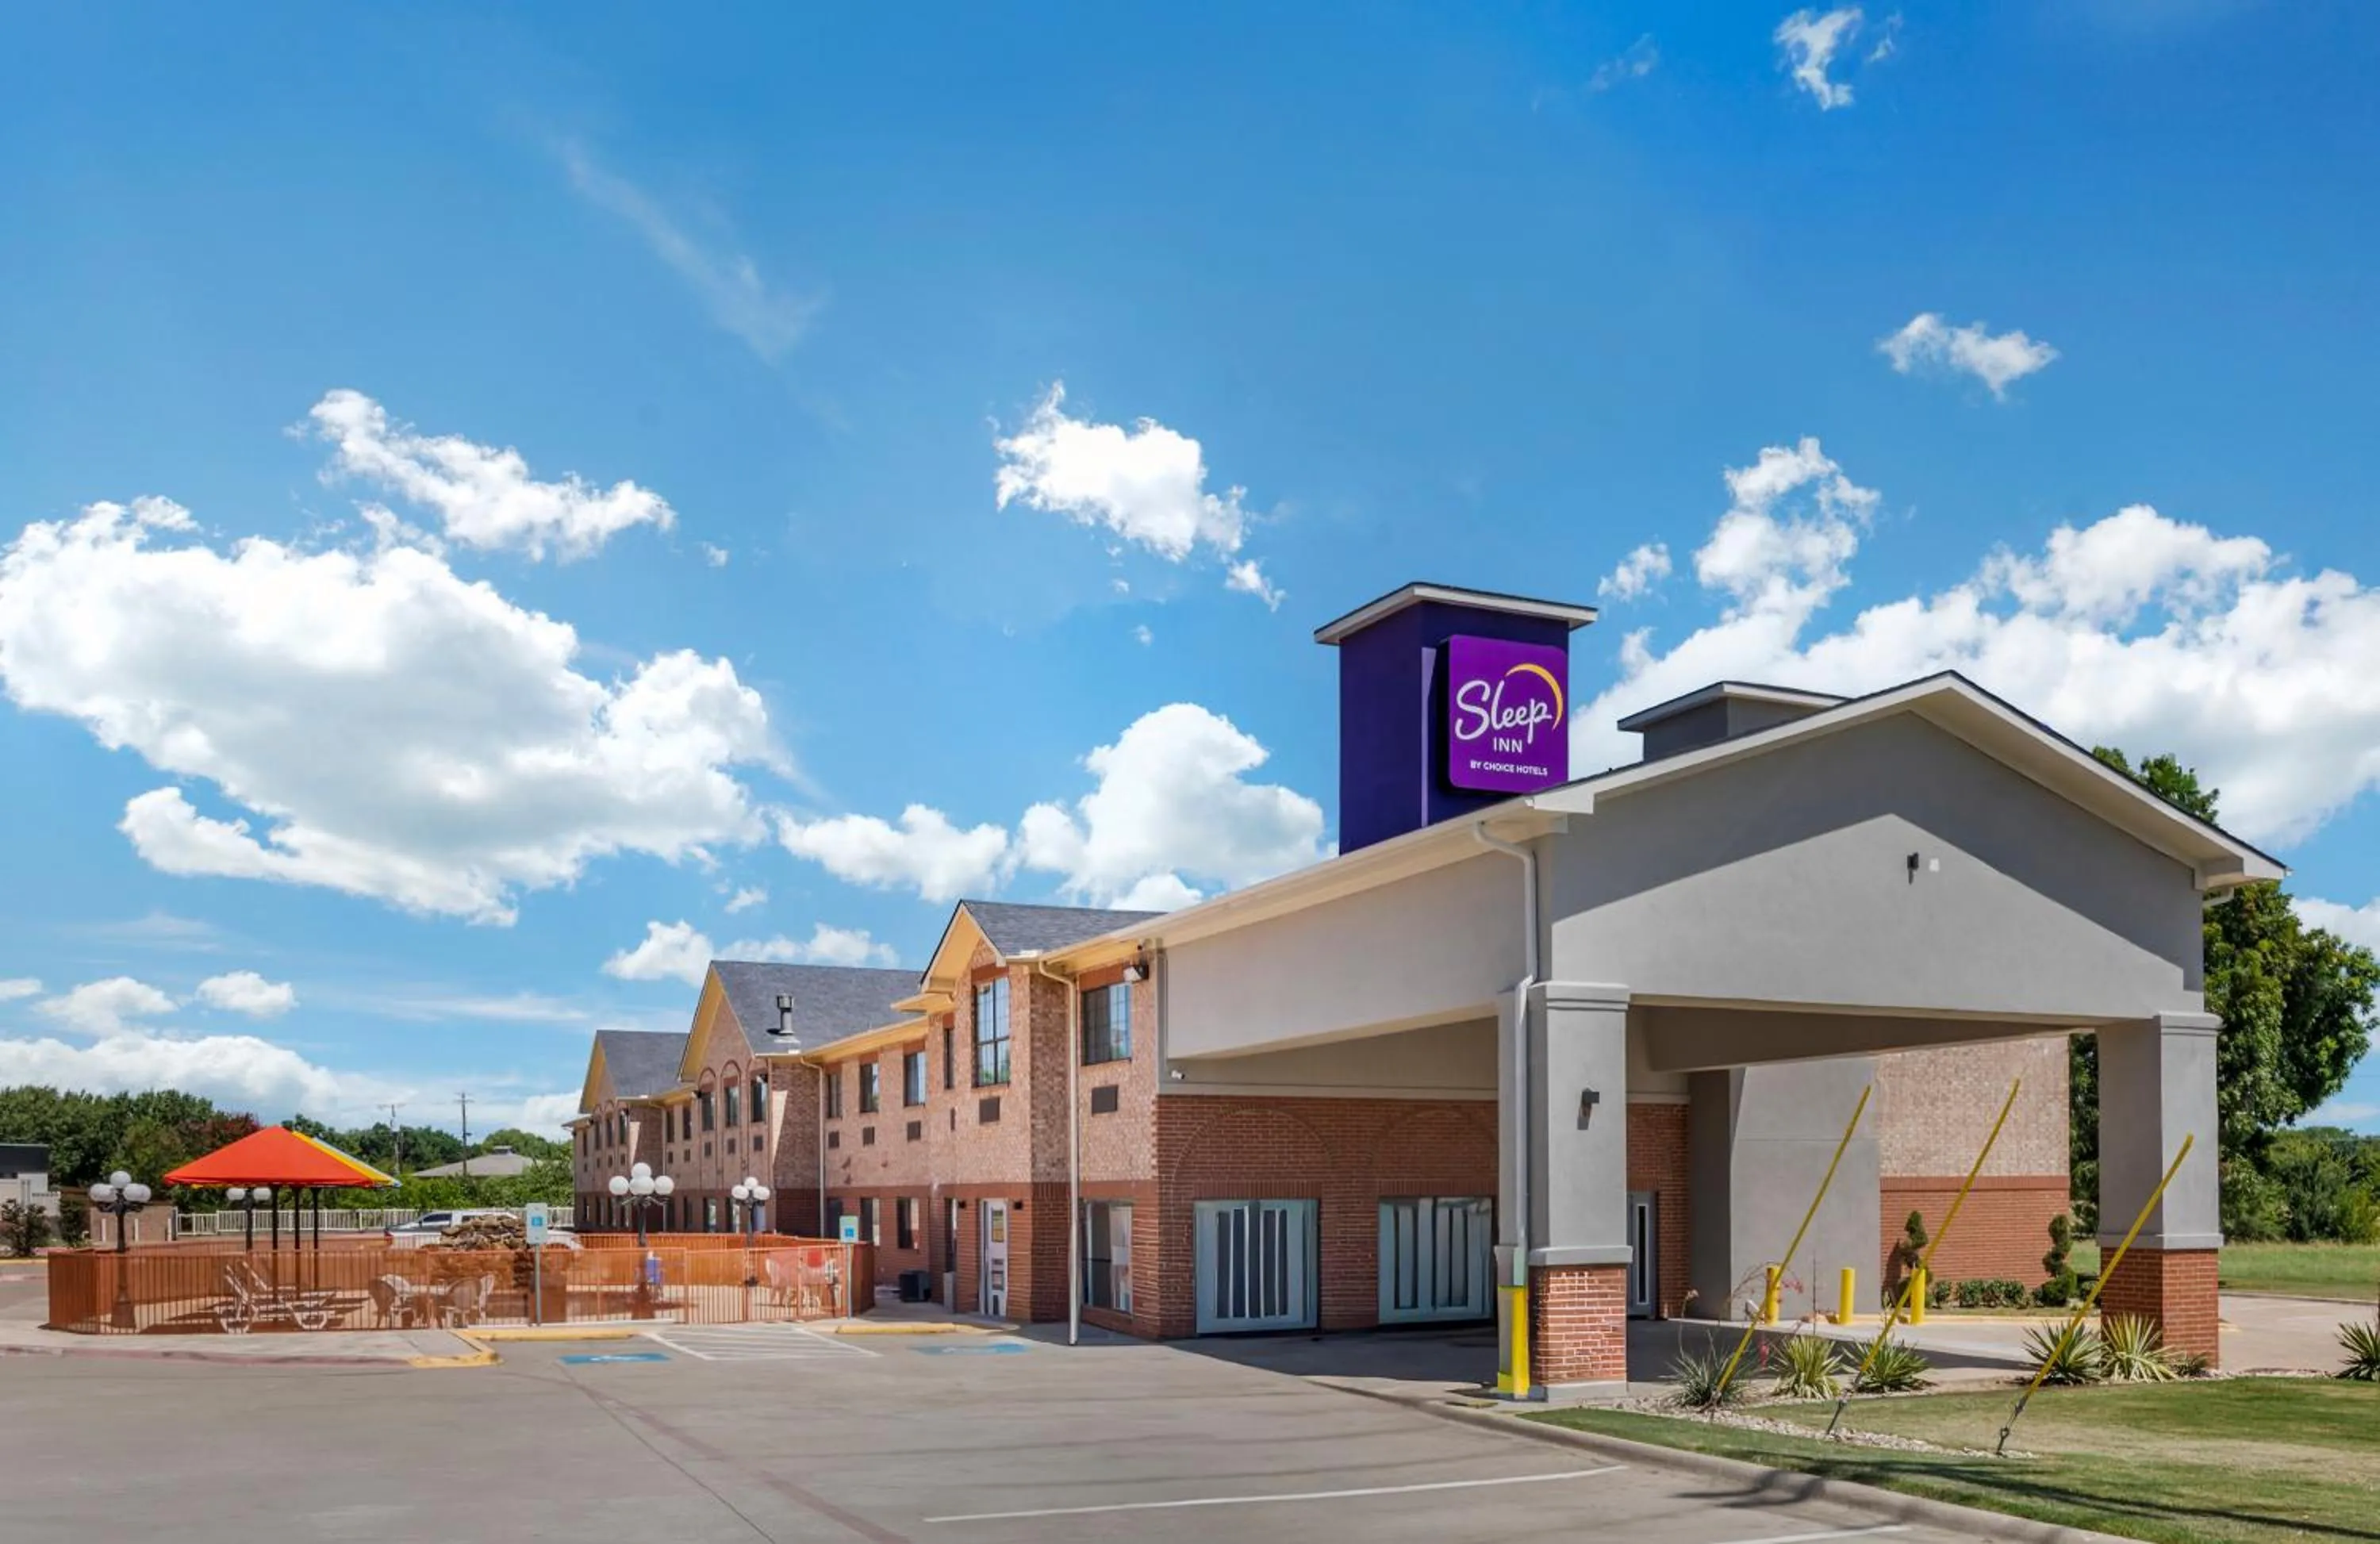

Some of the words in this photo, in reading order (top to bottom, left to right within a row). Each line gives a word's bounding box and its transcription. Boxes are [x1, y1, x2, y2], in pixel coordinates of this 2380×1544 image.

[1455, 680, 1553, 744] Sleep
[1493, 736, 1522, 753] INN
[1470, 759, 1481, 769] BY
[1483, 761, 1515, 773] CHOICE
[1516, 764, 1548, 776] HOTELS
